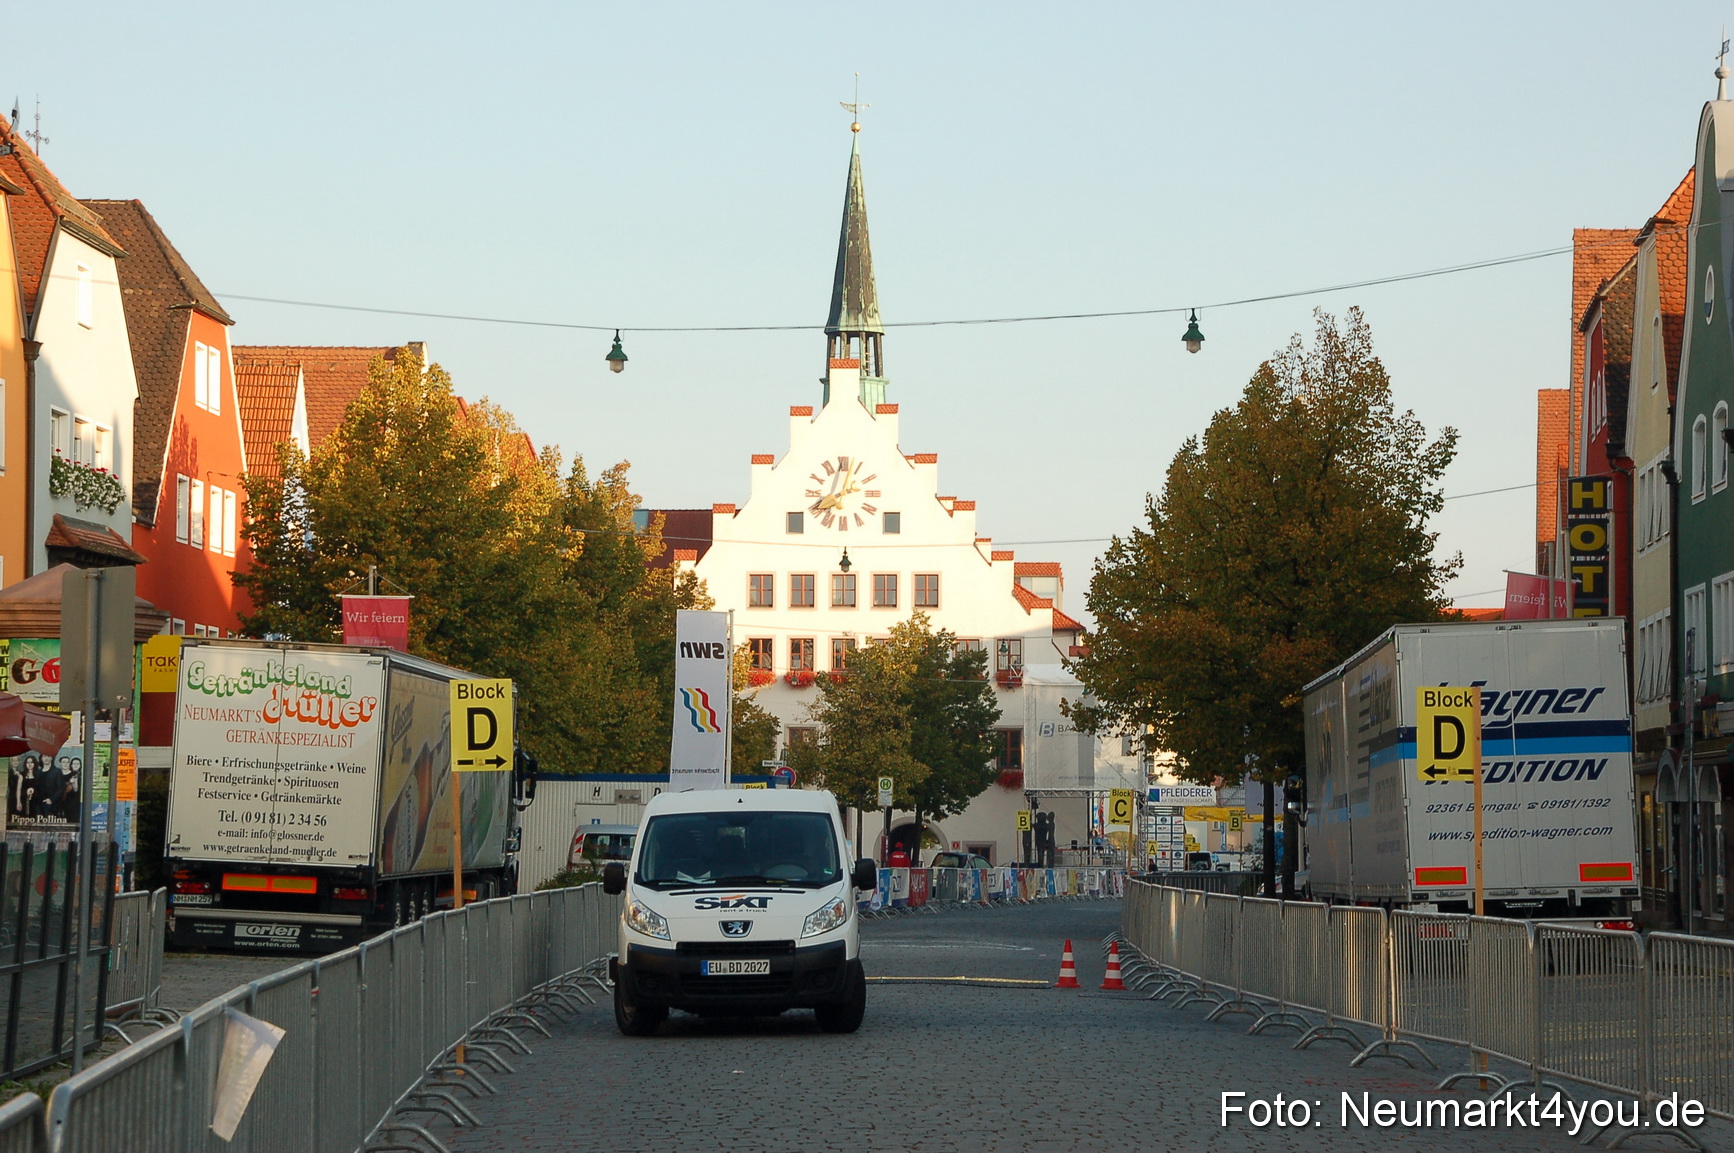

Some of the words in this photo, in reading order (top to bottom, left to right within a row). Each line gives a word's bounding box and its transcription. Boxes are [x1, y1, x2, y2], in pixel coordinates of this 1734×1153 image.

[346, 611, 369, 623] Wir
[371, 611, 405, 623] feiern
[187, 659, 353, 699] Getränkeland
[457, 682, 505, 699] Block
[262, 684, 378, 730] Müller
[1423, 690, 1474, 708] Block
[1438, 680, 1606, 728] agner
[466, 706, 498, 751] D
[225, 727, 356, 749] GETRÄNKESPEZIALIST
[1433, 715, 1466, 760] D
[186, 755, 213, 767] Biere
[221, 756, 328, 773] Erfrischungsgetränke
[336, 762, 367, 775] Weine
[202, 772, 275, 786] Trendgetränke
[283, 776, 339, 790] Spirituosen
[197, 788, 252, 801] Festservice
[260, 790, 342, 806] Getränkemärkte
[593, 786, 601, 797] H
[1111, 789, 1132, 798] Block
[1160, 788, 1213, 798] PFLEIDERER
[1114, 799, 1128, 818] C
[1425, 804, 1465, 814] 92361
[1466, 802, 1521, 813] Brngau
[1540, 798, 1612, 810] 09181/1392
[11, 814, 36, 826] Pippo
[37, 814, 68, 824] Pollina
[218, 809, 238, 823] Tel.
[1019, 816, 1027, 827] B
[1232, 817, 1240, 828] B
[217, 828, 249, 839] e-mail:
[250, 829, 325, 842] info@glossner.de
[202, 843, 338, 859] www.getraenkeland-mueller.de
[1150, 844, 1156, 853] A
[246, 923, 301, 937] orten
[234, 940, 301, 949] www.orten.com
[708, 962, 722, 974] EU
[728, 962, 742, 973] BD
